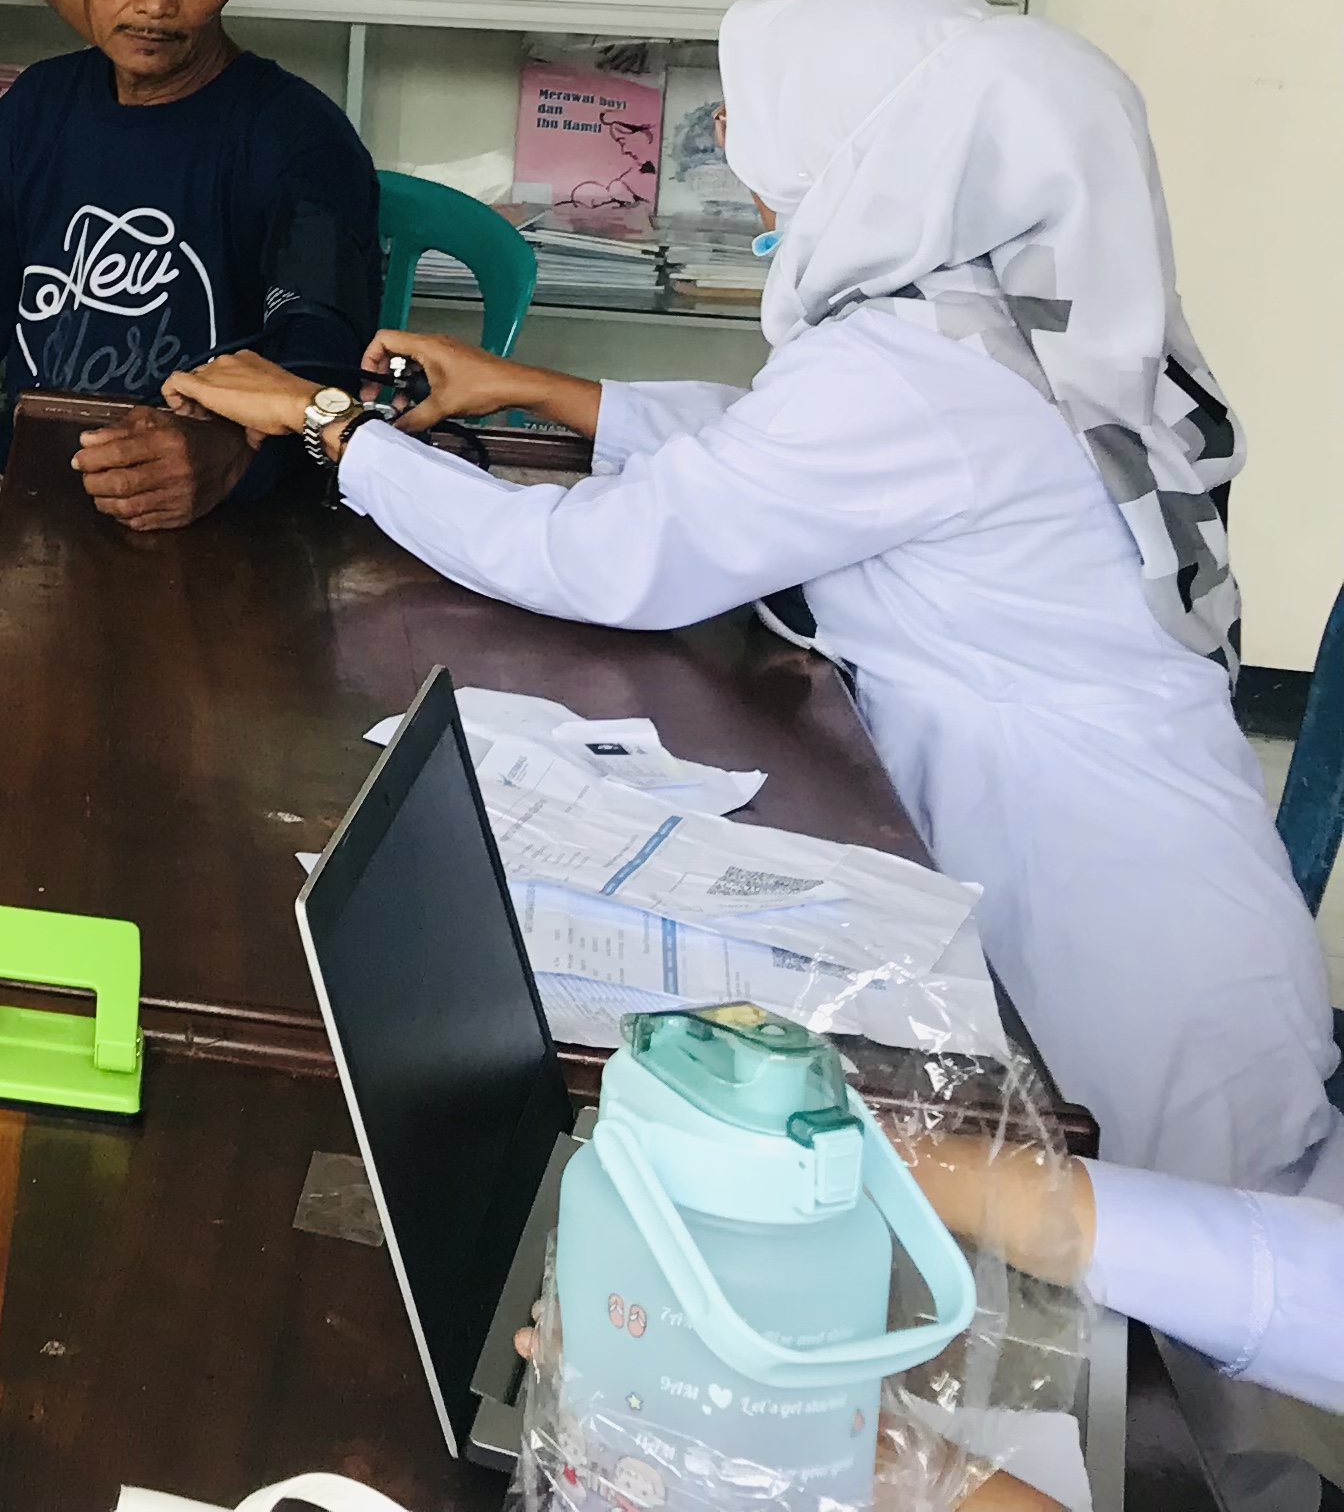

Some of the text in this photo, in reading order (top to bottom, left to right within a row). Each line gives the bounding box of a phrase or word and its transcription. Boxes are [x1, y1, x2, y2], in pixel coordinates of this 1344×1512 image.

[537, 103, 564, 115] dan
[536, 117, 558, 129] Ibu
[18, 204, 180, 321] New
